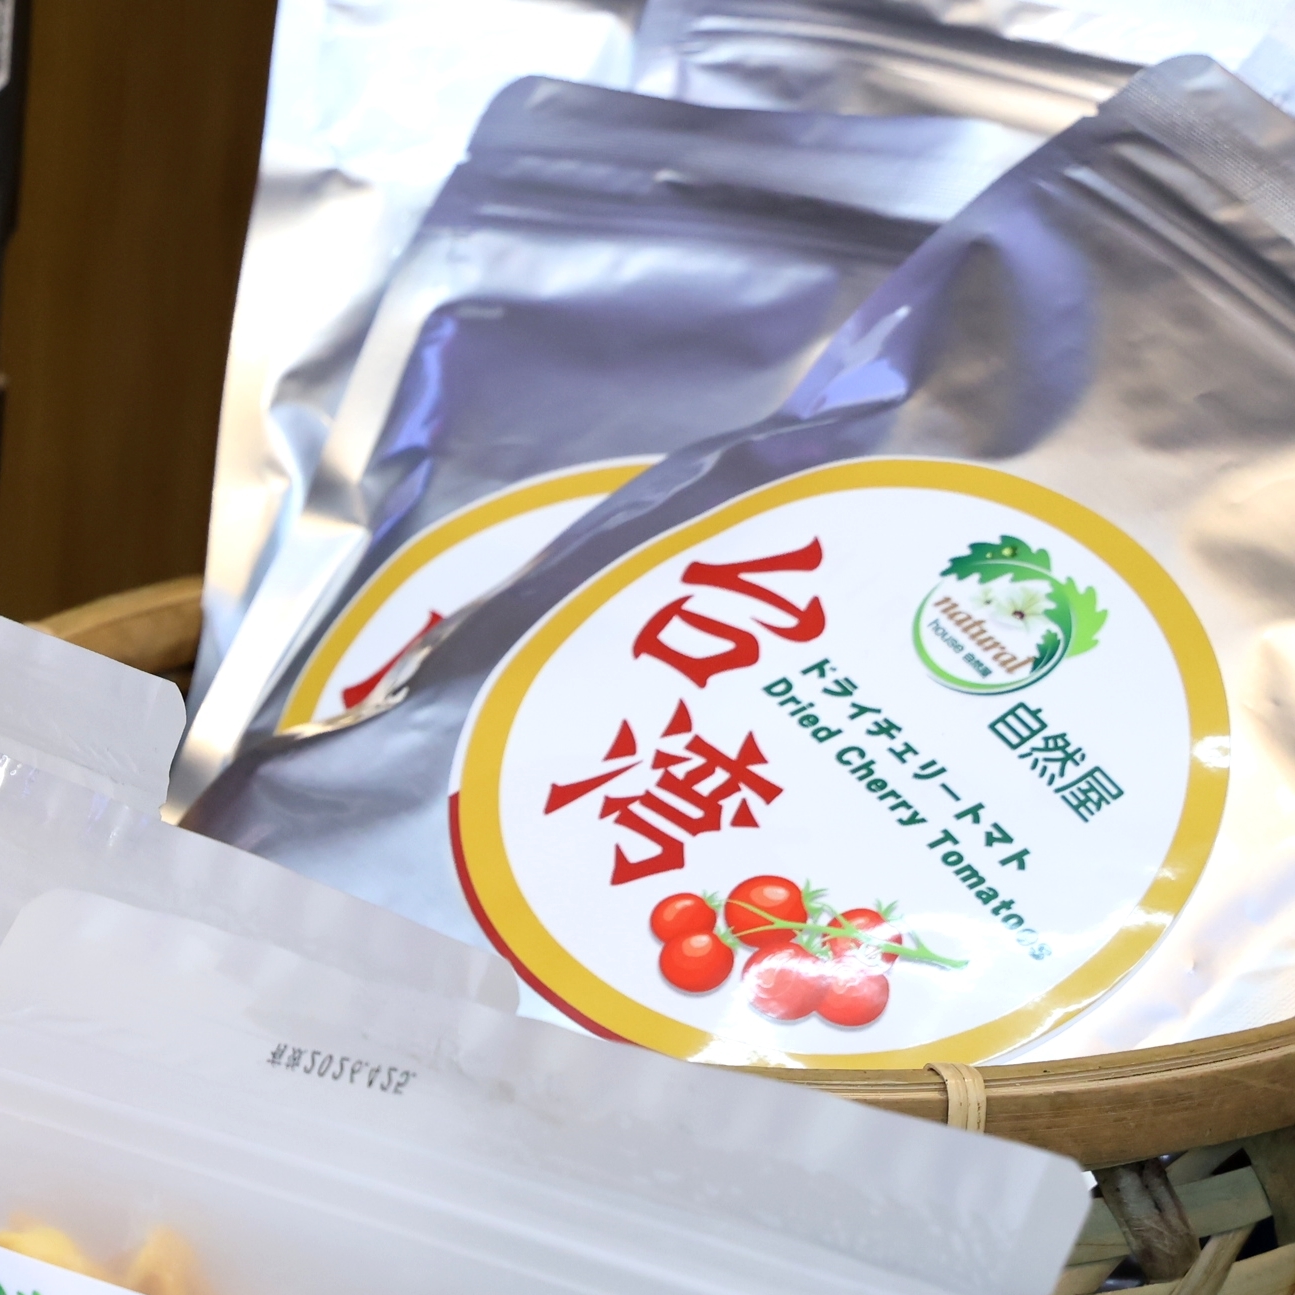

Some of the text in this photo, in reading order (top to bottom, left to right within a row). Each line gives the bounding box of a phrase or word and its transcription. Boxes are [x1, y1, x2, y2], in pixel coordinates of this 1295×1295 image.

[928, 618, 964, 654] house
[934, 596, 1035, 675] natural
[544, 536, 825, 885] 台湾
[762, 677, 843, 744] Dried
[835, 746, 927, 827] Cherry
[801, 658, 1030, 870] ドライチェリートマト
[988, 701, 1124, 823] 自然屋
